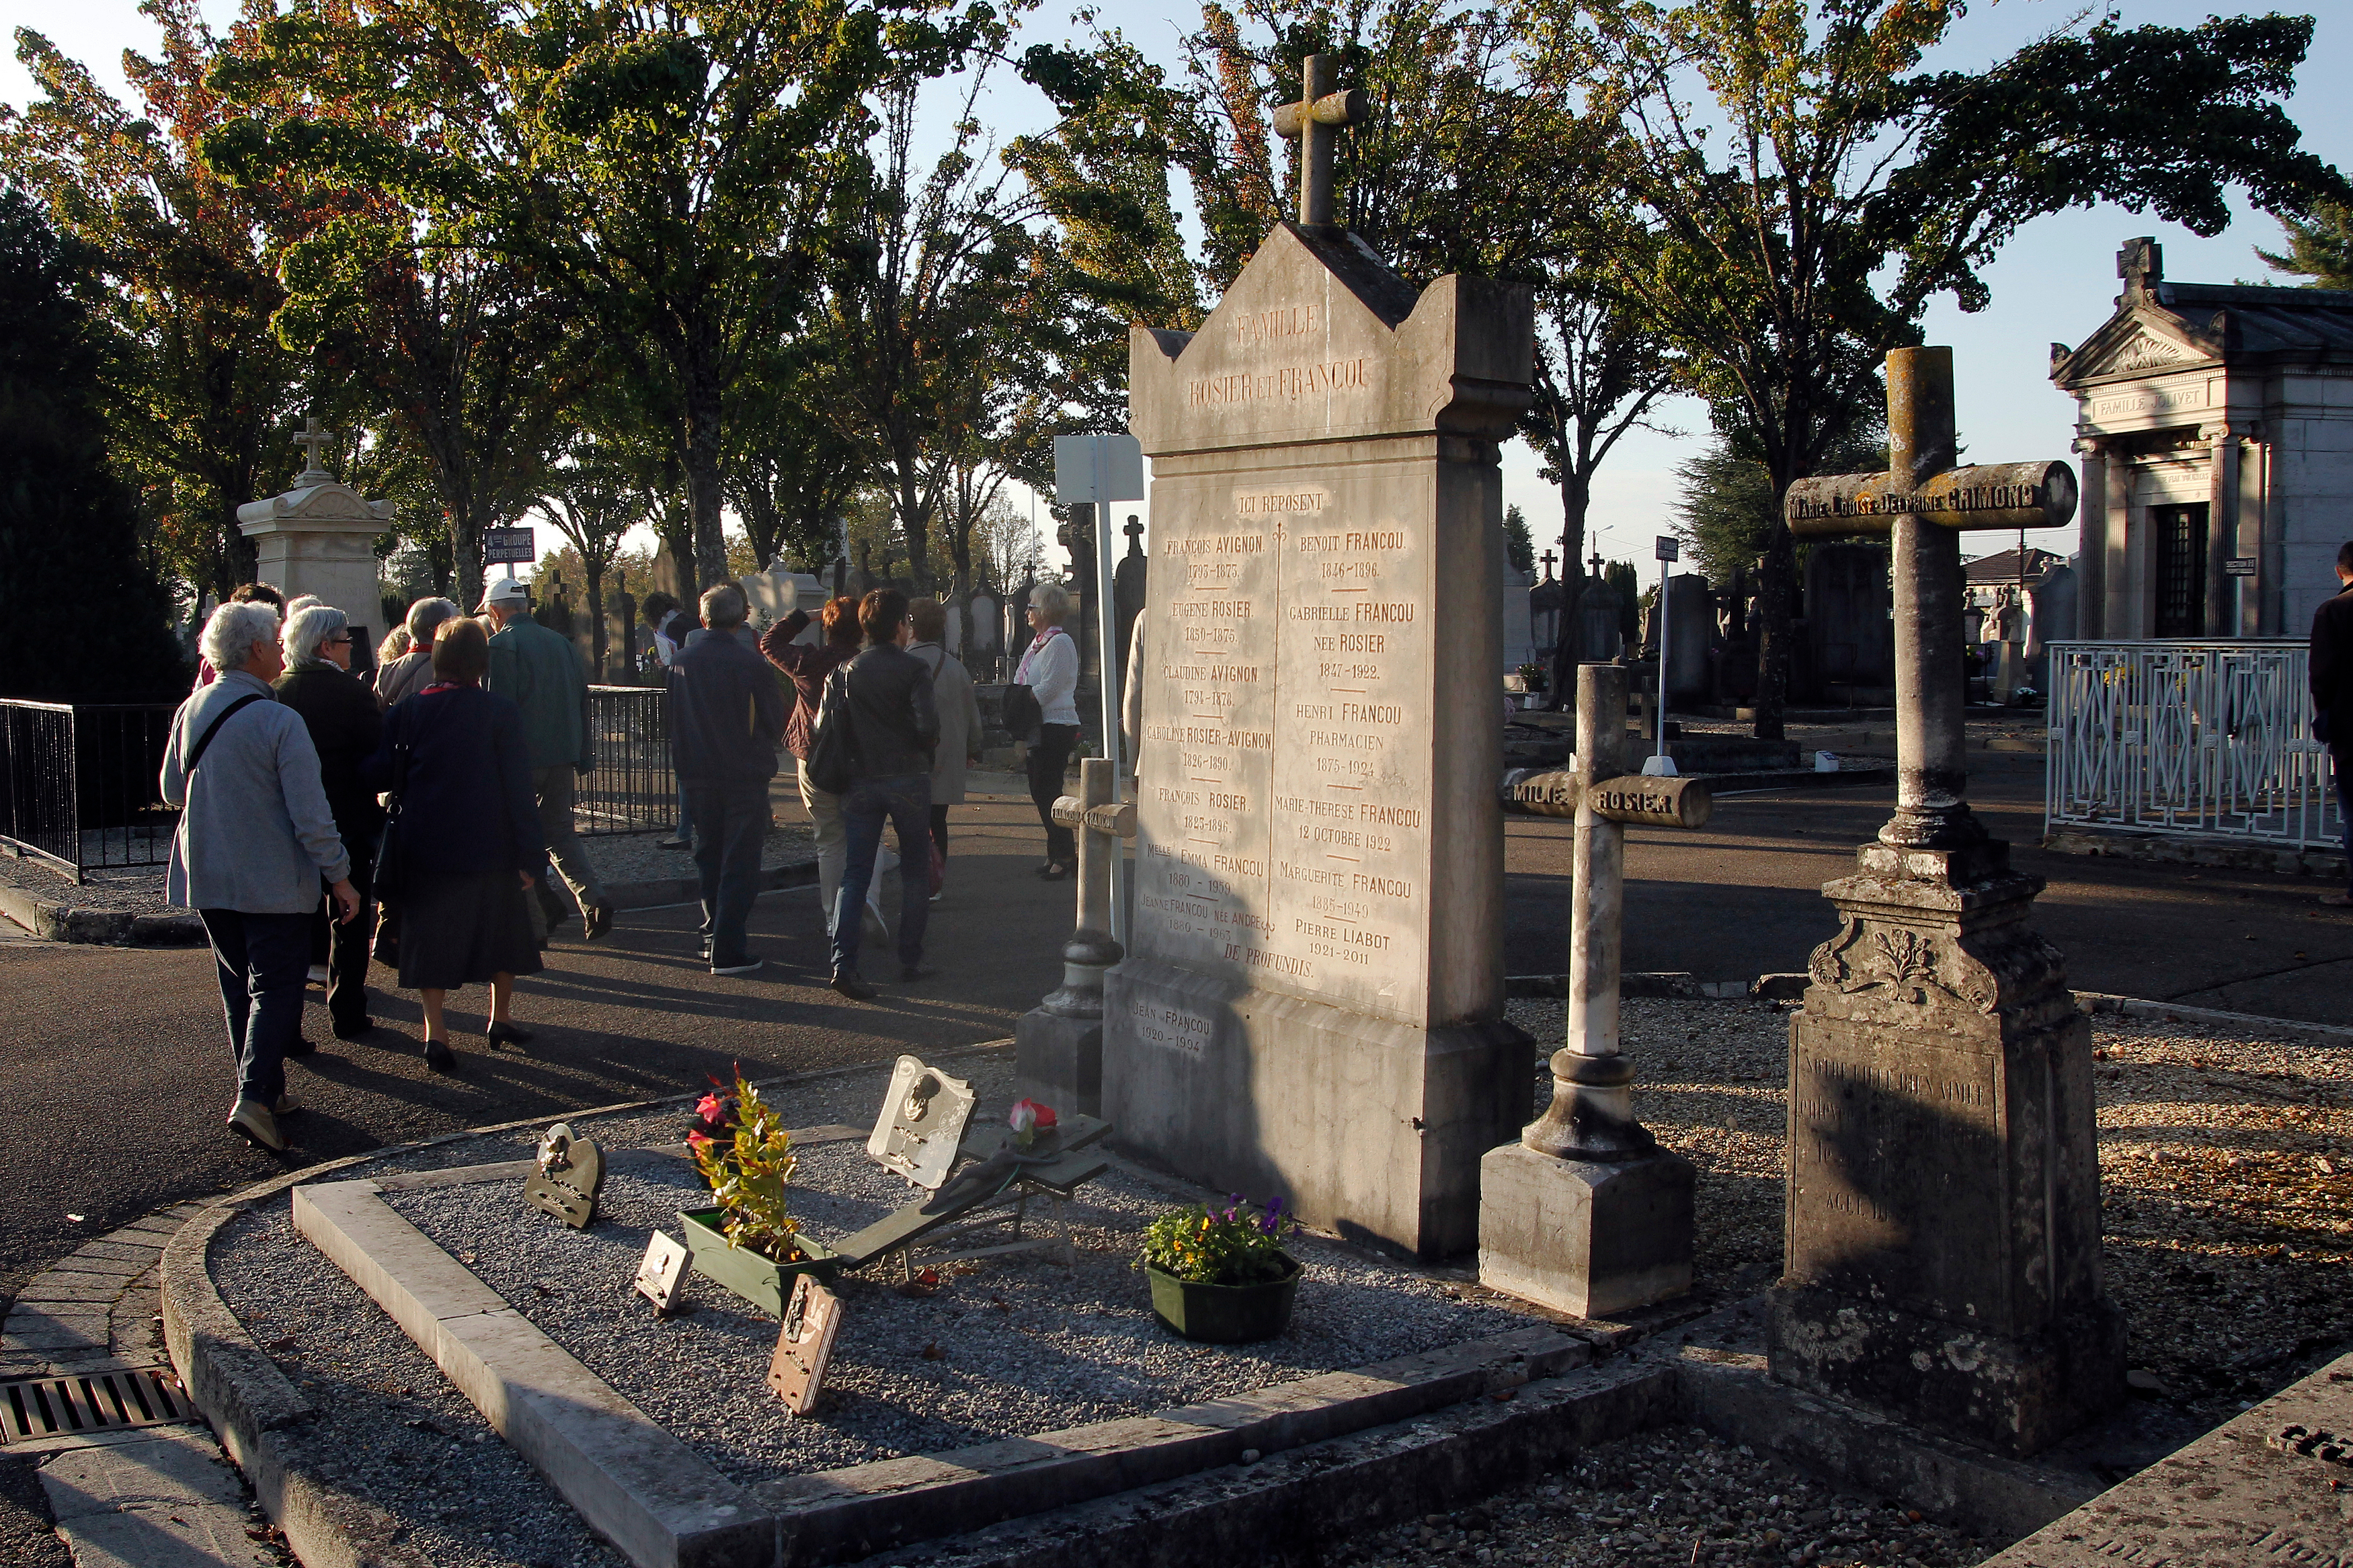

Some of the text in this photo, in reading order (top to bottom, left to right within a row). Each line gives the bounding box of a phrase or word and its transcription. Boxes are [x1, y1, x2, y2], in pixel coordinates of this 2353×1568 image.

[1237, 304, 1319, 342] FAMILLE
[1189, 358, 1372, 406] ROSIER ET FRANCOU
[2101, 390, 2200, 415] FAMILLE JOLIVET
[1240, 493, 1323, 513] ICI REPOSENT
[1948, 485, 2034, 510] GRIMOND
[503, 534, 532, 546] GROUPE
[1300, 535, 1341, 552] BENOIT
[488, 547, 533, 559] PERPETUELLES
[1289, 602, 1414, 622] GABRIELLE FRANCOU
[1314, 633, 1386, 653] NEE ROSIER
[1164, 665, 1207, 681] CLAUDINE
[1296, 703, 1402, 725] HENRI FRANCOU
[1147, 726, 1185, 743] CAROLINE
[1309, 730, 1385, 751] PHARMACIEN
[1597, 790, 1673, 814] ROSIER
[1360, 803, 1421, 829] FRANCOU
[1299, 824, 1392, 852] 12 OCTOBRE 1922
[1181, 848, 1208, 868] EMMA
[1213, 854, 1264, 877] FRANCOU
[1168, 873, 1190, 888] 1880
[1207, 879, 1231, 896] 1959
[1279, 861, 1412, 899] MARGUERITE FRANCOU
[1140, 893, 1169, 911] JEANNE
[1170, 899, 1209, 919] FRANCOU
[1209, 927, 1232, 941] 1963
[1295, 918, 1390, 950] PIERRE LIABOT
[1224, 942, 1241, 961] DE
[1133, 1002, 1209, 1036] JEAN FRANCOU
[1142, 1026, 1164, 1042] 1920
[1176, 1035, 1200, 1053] 1994
